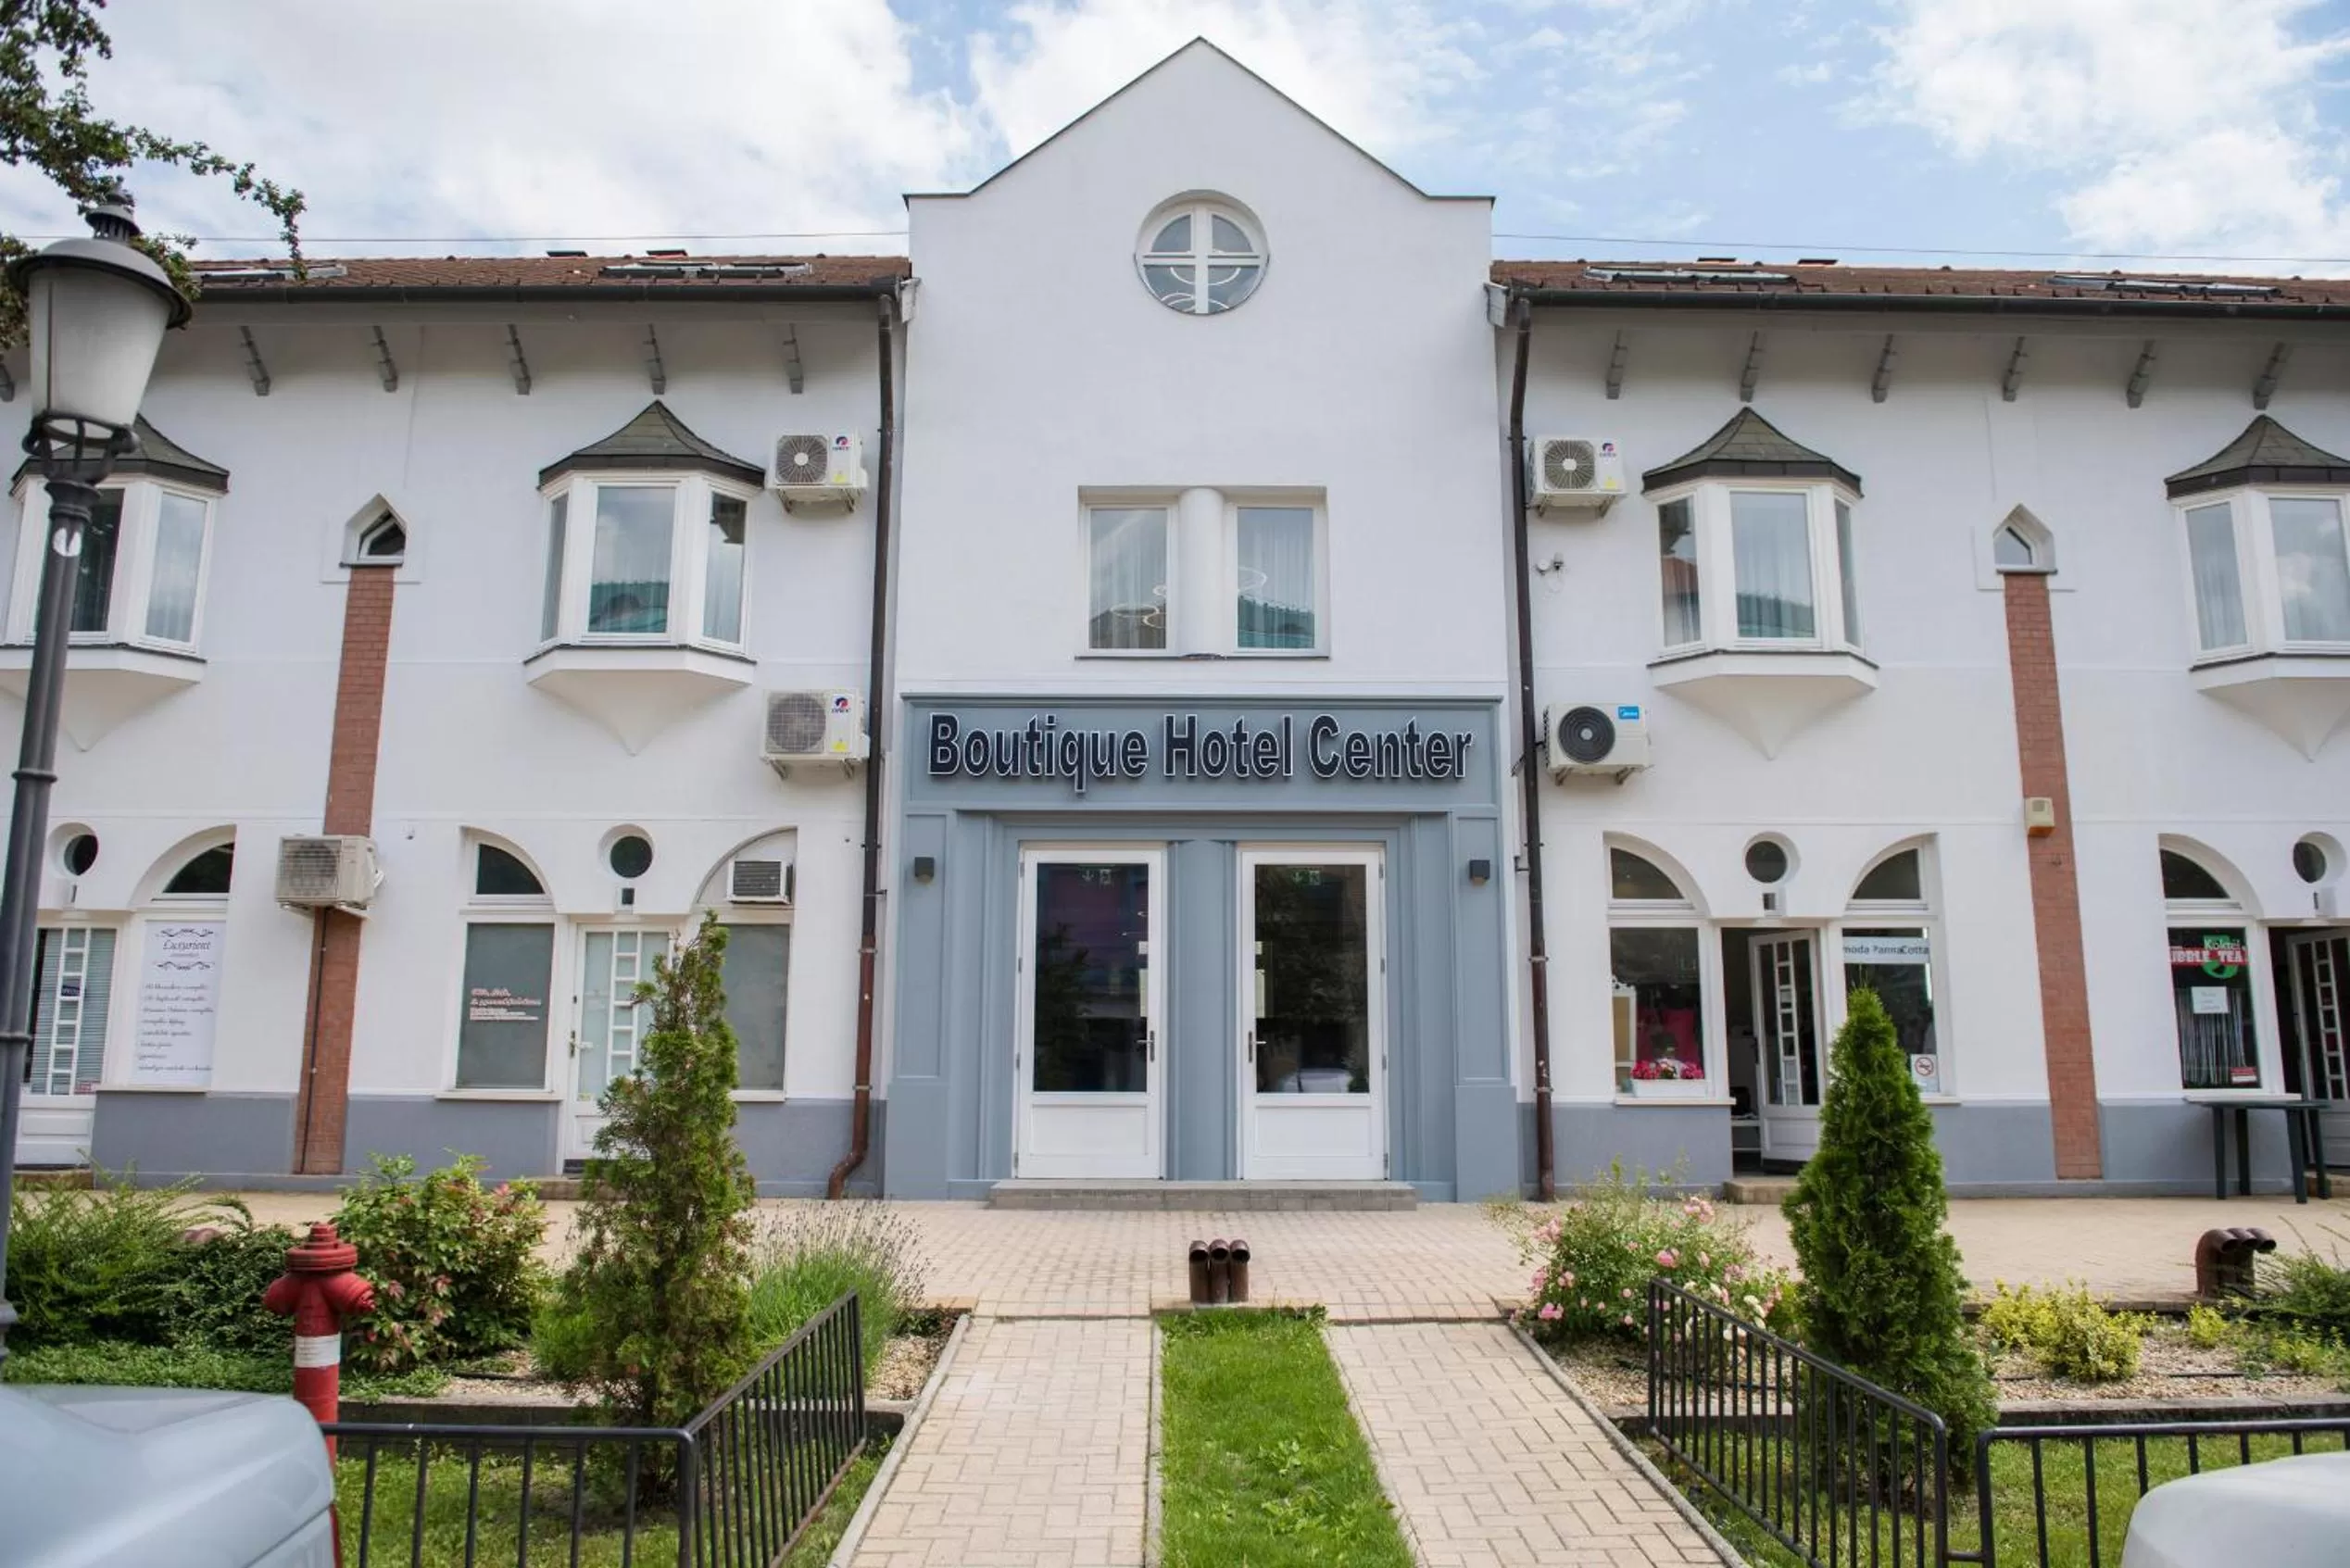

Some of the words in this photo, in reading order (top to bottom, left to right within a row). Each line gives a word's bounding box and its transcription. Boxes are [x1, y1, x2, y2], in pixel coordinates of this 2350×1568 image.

[927, 712, 1150, 794] Boutique
[1163, 712, 1294, 778] Hotel
[1308, 713, 1474, 780] Center
